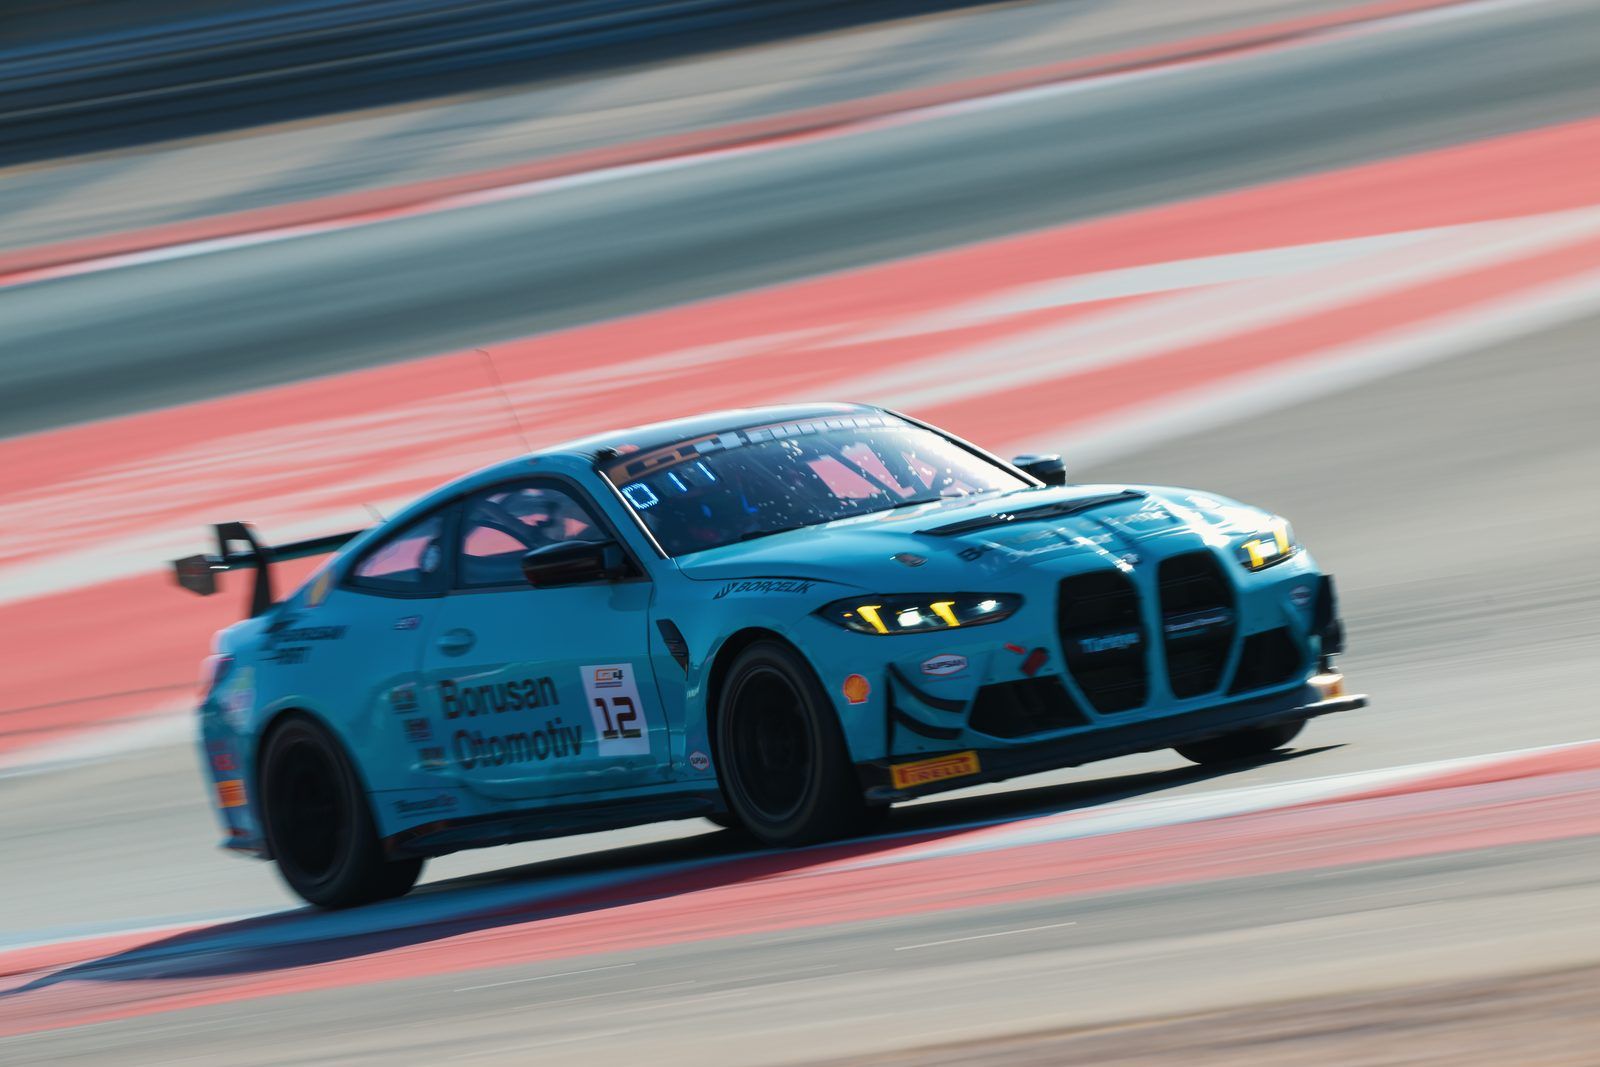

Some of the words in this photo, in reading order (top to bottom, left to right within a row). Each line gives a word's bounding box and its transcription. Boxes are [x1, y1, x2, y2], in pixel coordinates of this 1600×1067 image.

[438, 676, 559, 719] Borusan
[594, 696, 642, 739] 12
[454, 717, 581, 769] Otomotiv
[896, 756, 972, 785] PIRELLI
